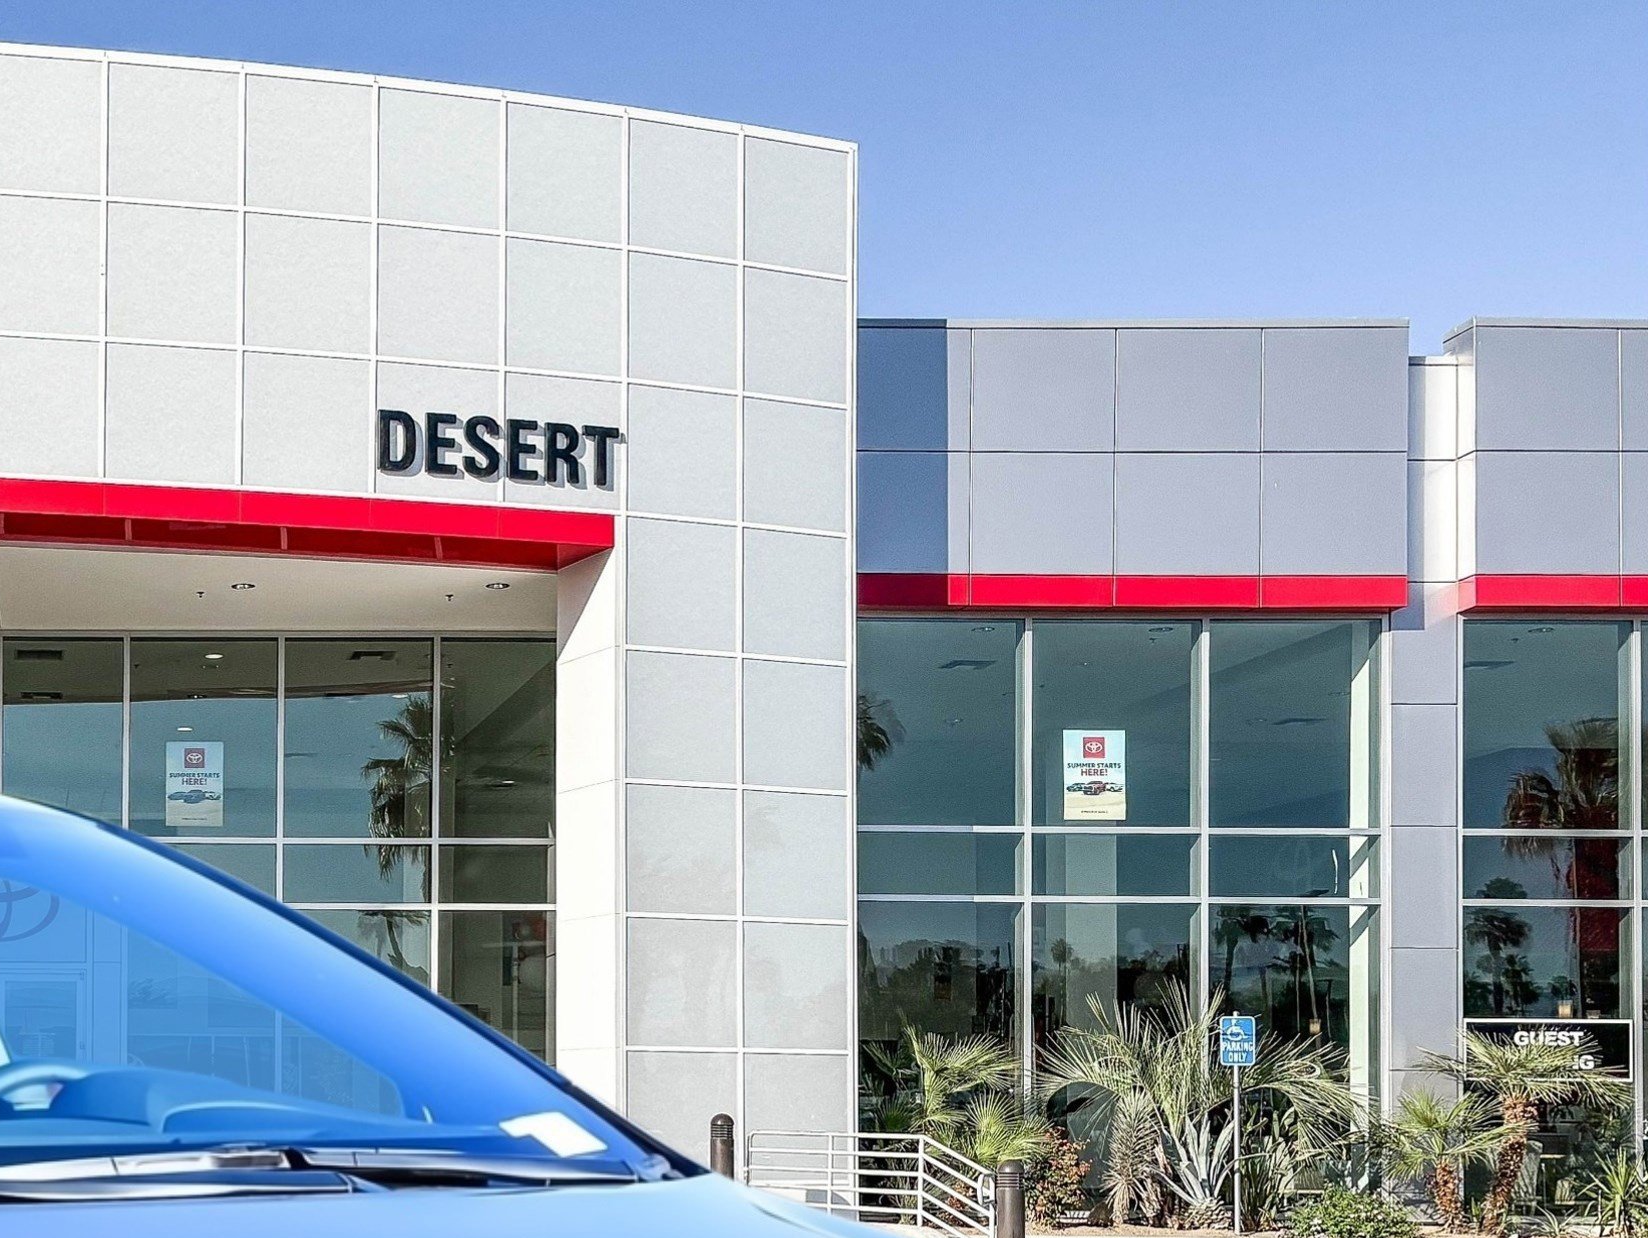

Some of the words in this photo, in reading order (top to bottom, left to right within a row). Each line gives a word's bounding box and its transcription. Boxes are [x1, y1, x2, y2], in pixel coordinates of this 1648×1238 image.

[376, 409, 620, 486] DESERT
[1080, 768, 1108, 776] HERE!
[1513, 1030, 1584, 1047] GUEST
[1222, 1041, 1254, 1051] PARKING
[1228, 1051, 1248, 1062] ONLY
